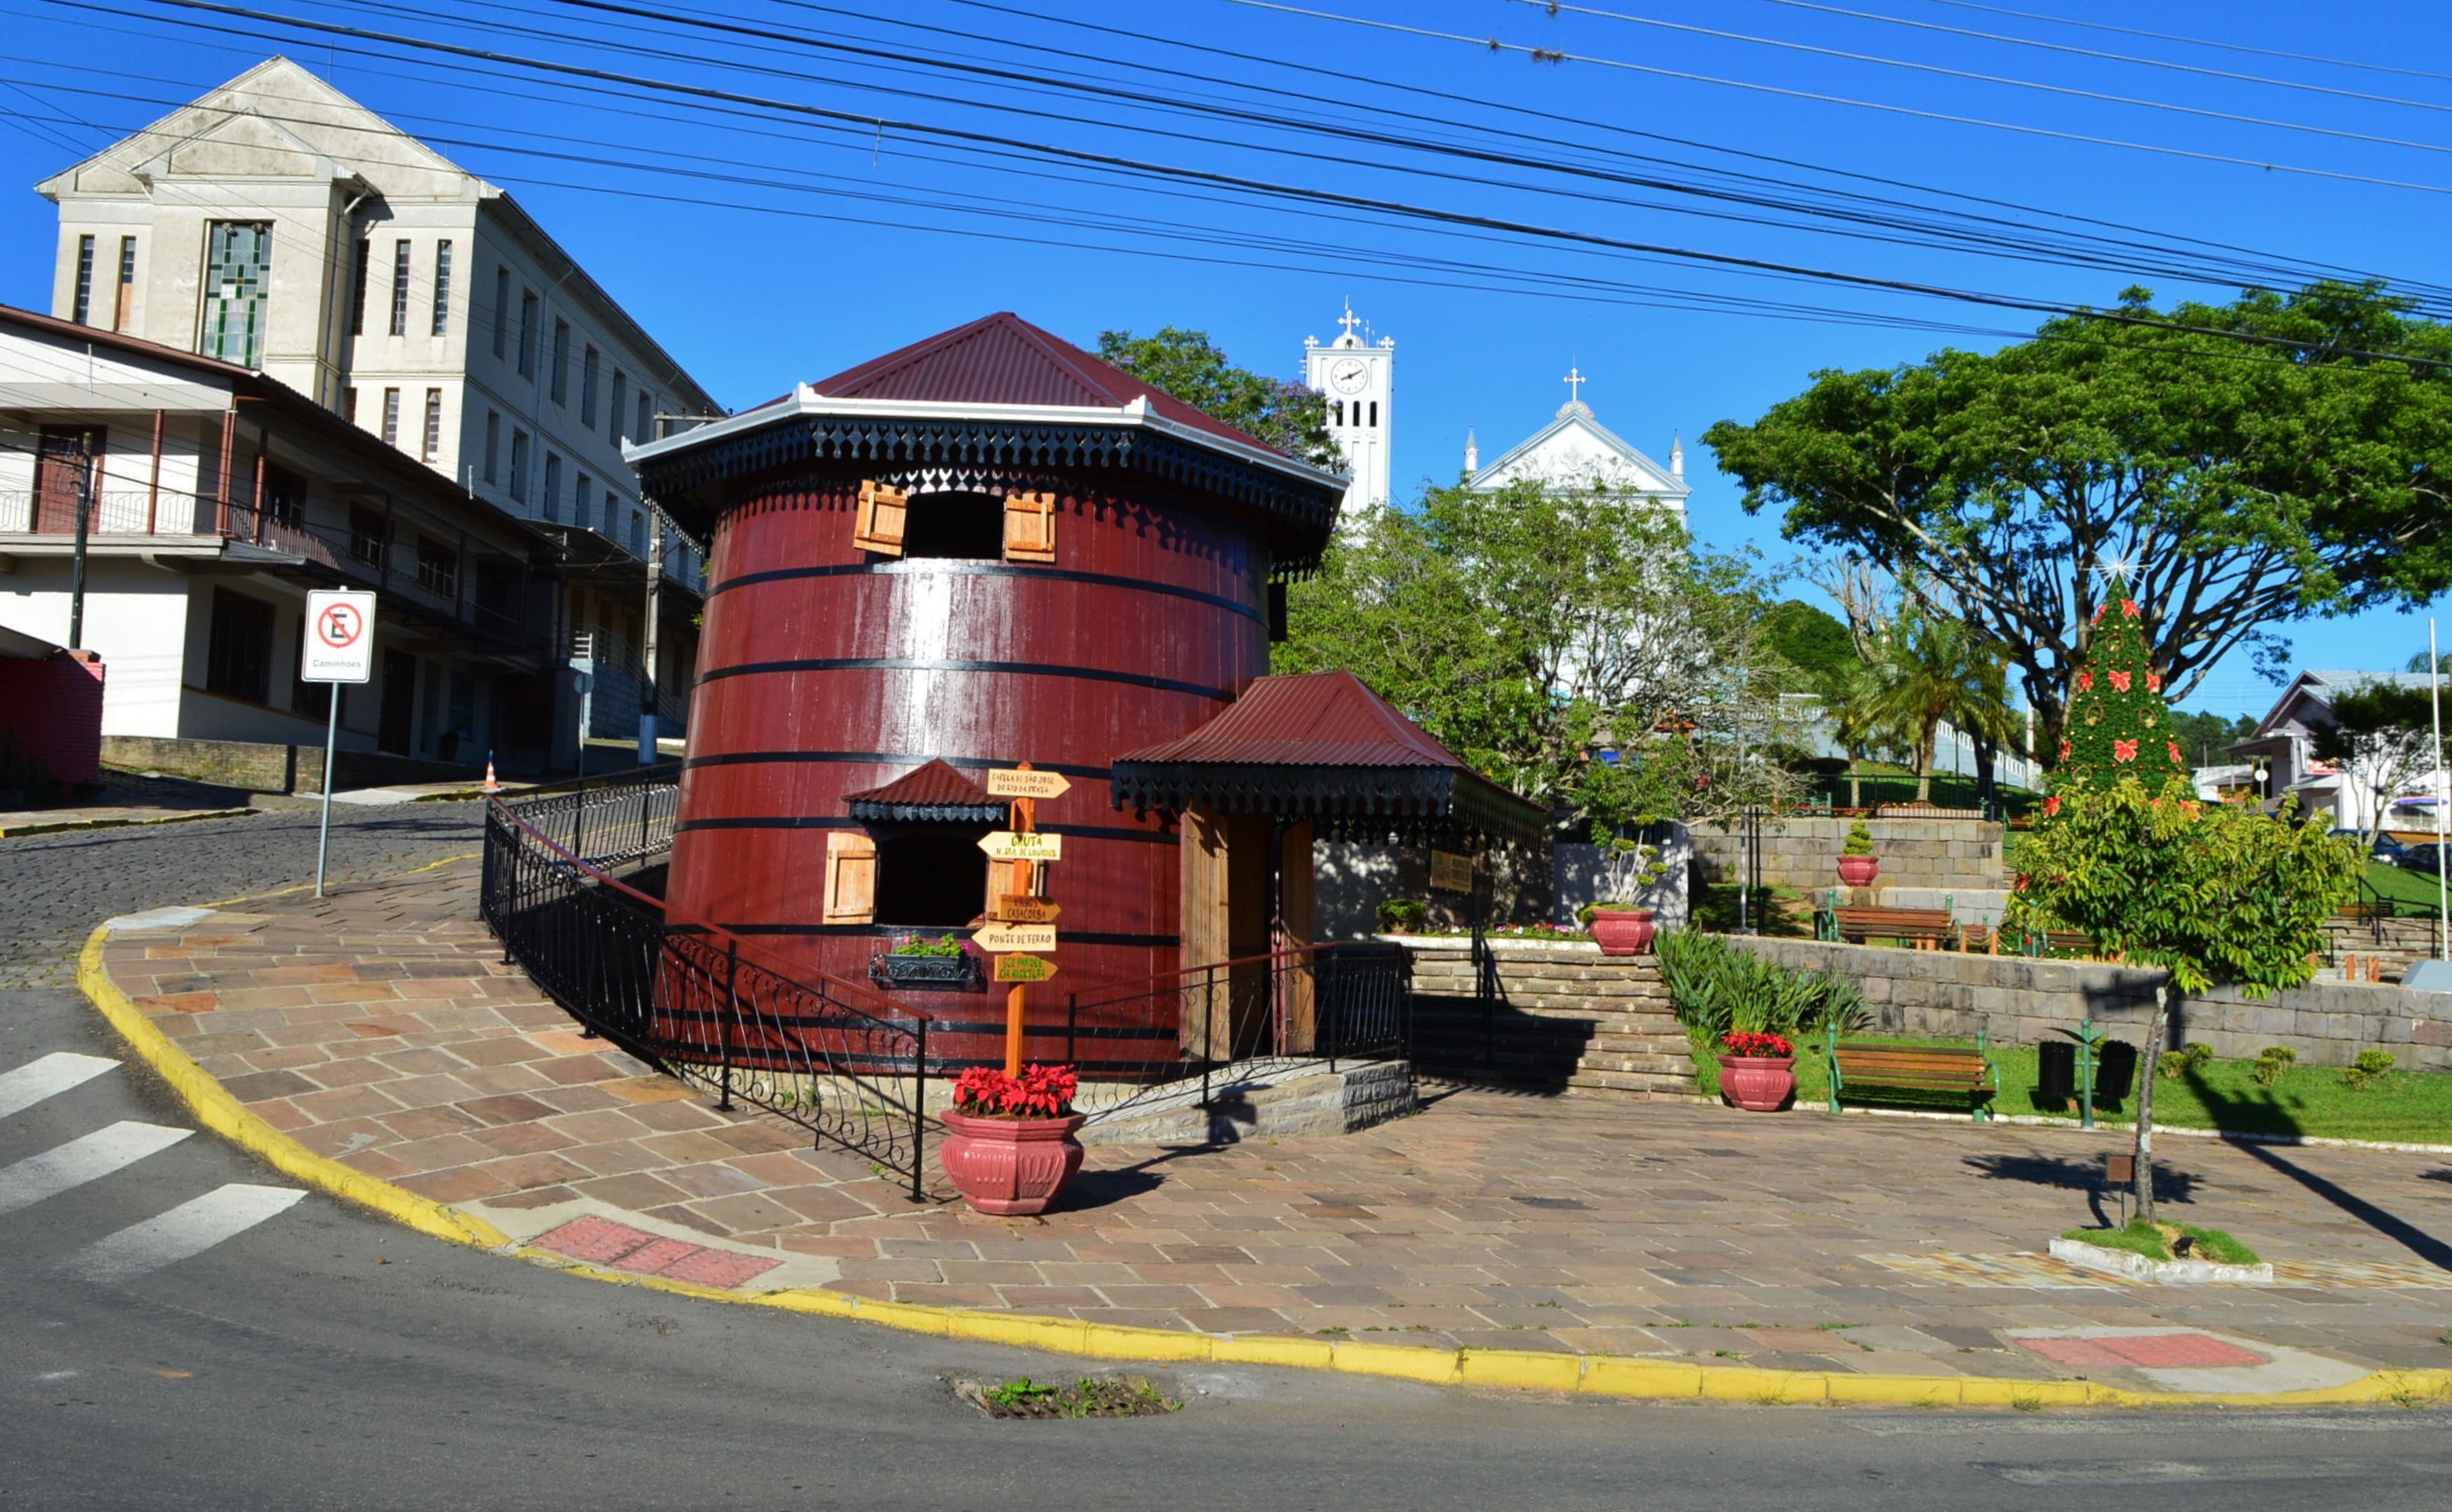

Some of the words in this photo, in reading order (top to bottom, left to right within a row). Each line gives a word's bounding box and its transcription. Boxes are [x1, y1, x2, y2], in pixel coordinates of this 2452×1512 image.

[312, 659, 361, 668] Caminhões
[992, 772, 1014, 783] CAPELA
[1028, 785, 1049, 794] PRATA
[1011, 836, 1042, 847] GRUTA
[1028, 848, 1056, 858] LOURDES
[1014, 896, 1039, 908] VINHOS
[989, 933, 1014, 944] PONTE
[1017, 934, 1025, 944] DE
[1027, 934, 1051, 944] FERRO
